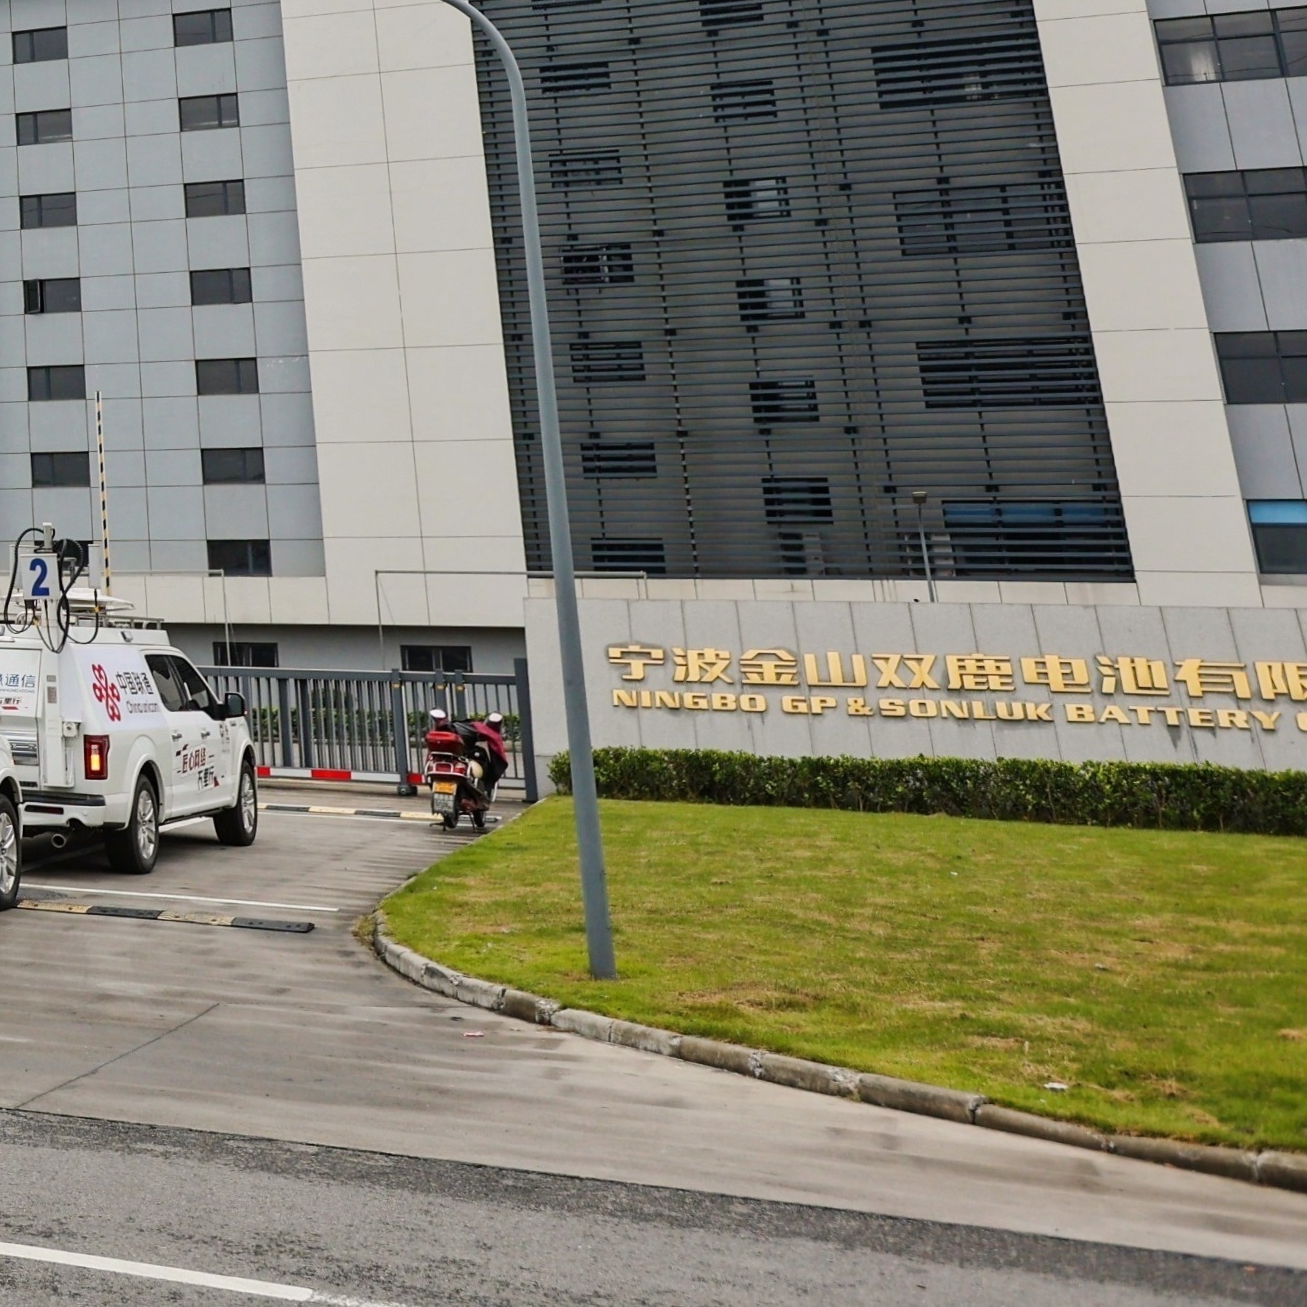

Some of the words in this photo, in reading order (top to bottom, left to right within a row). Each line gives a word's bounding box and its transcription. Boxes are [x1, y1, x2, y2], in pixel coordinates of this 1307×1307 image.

[29, 557, 50, 597] 2
[608, 645, 1307, 701] 宁波金山双鹿电池有限
[612, 689, 767, 713] NINGBO
[781, 694, 837, 715] GP
[847, 696, 874, 716] &
[878, 698, 1054, 722] SONLUK
[1065, 703, 1281, 731] BATTERY
